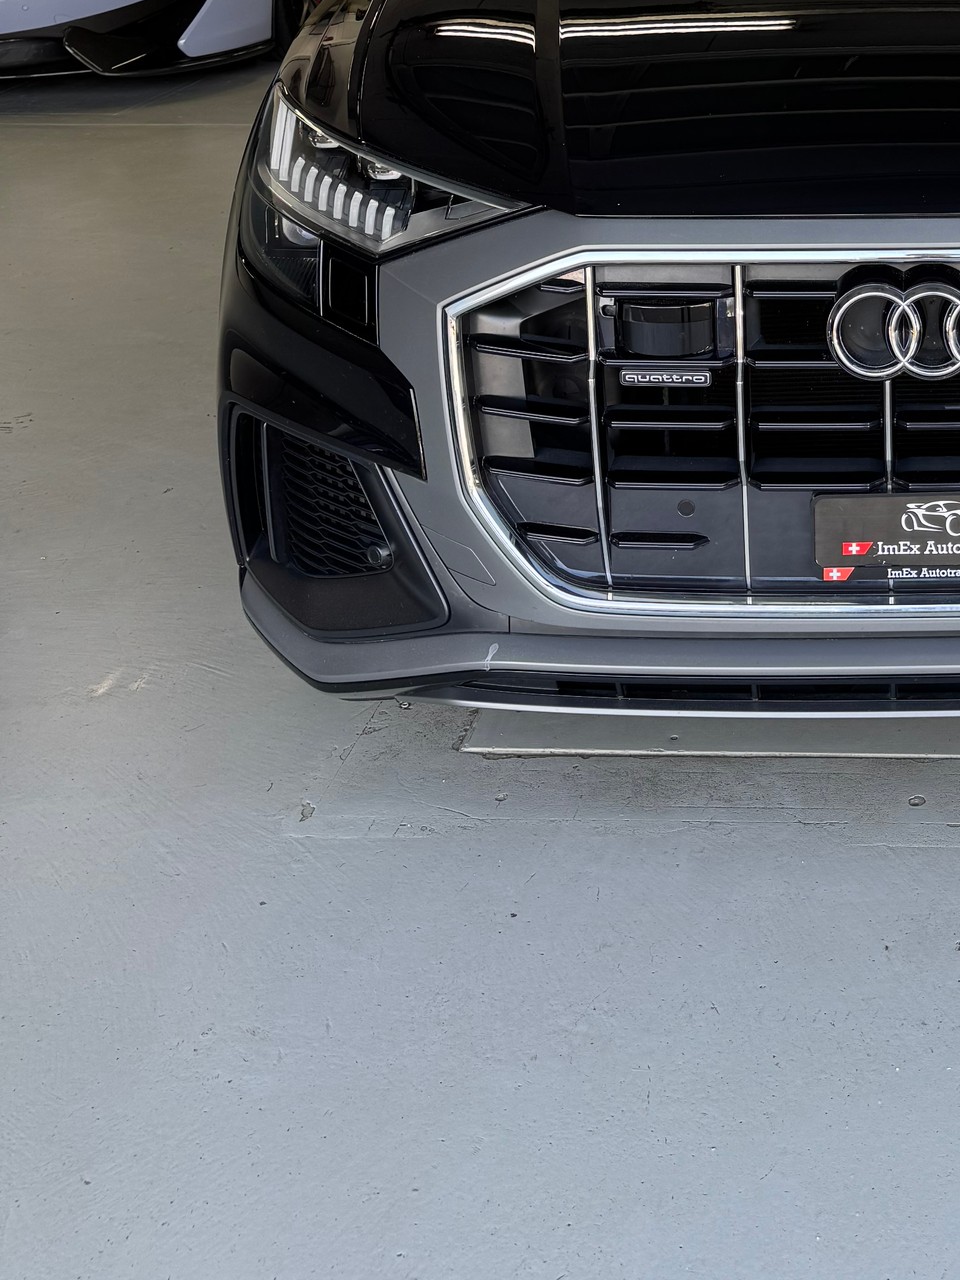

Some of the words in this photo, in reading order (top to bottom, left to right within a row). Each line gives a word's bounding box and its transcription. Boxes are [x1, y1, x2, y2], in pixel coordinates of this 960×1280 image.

[625, 374, 705, 383] quattro
[877, 541, 921, 555] ImEx
[887, 568, 918, 578] ImEx
